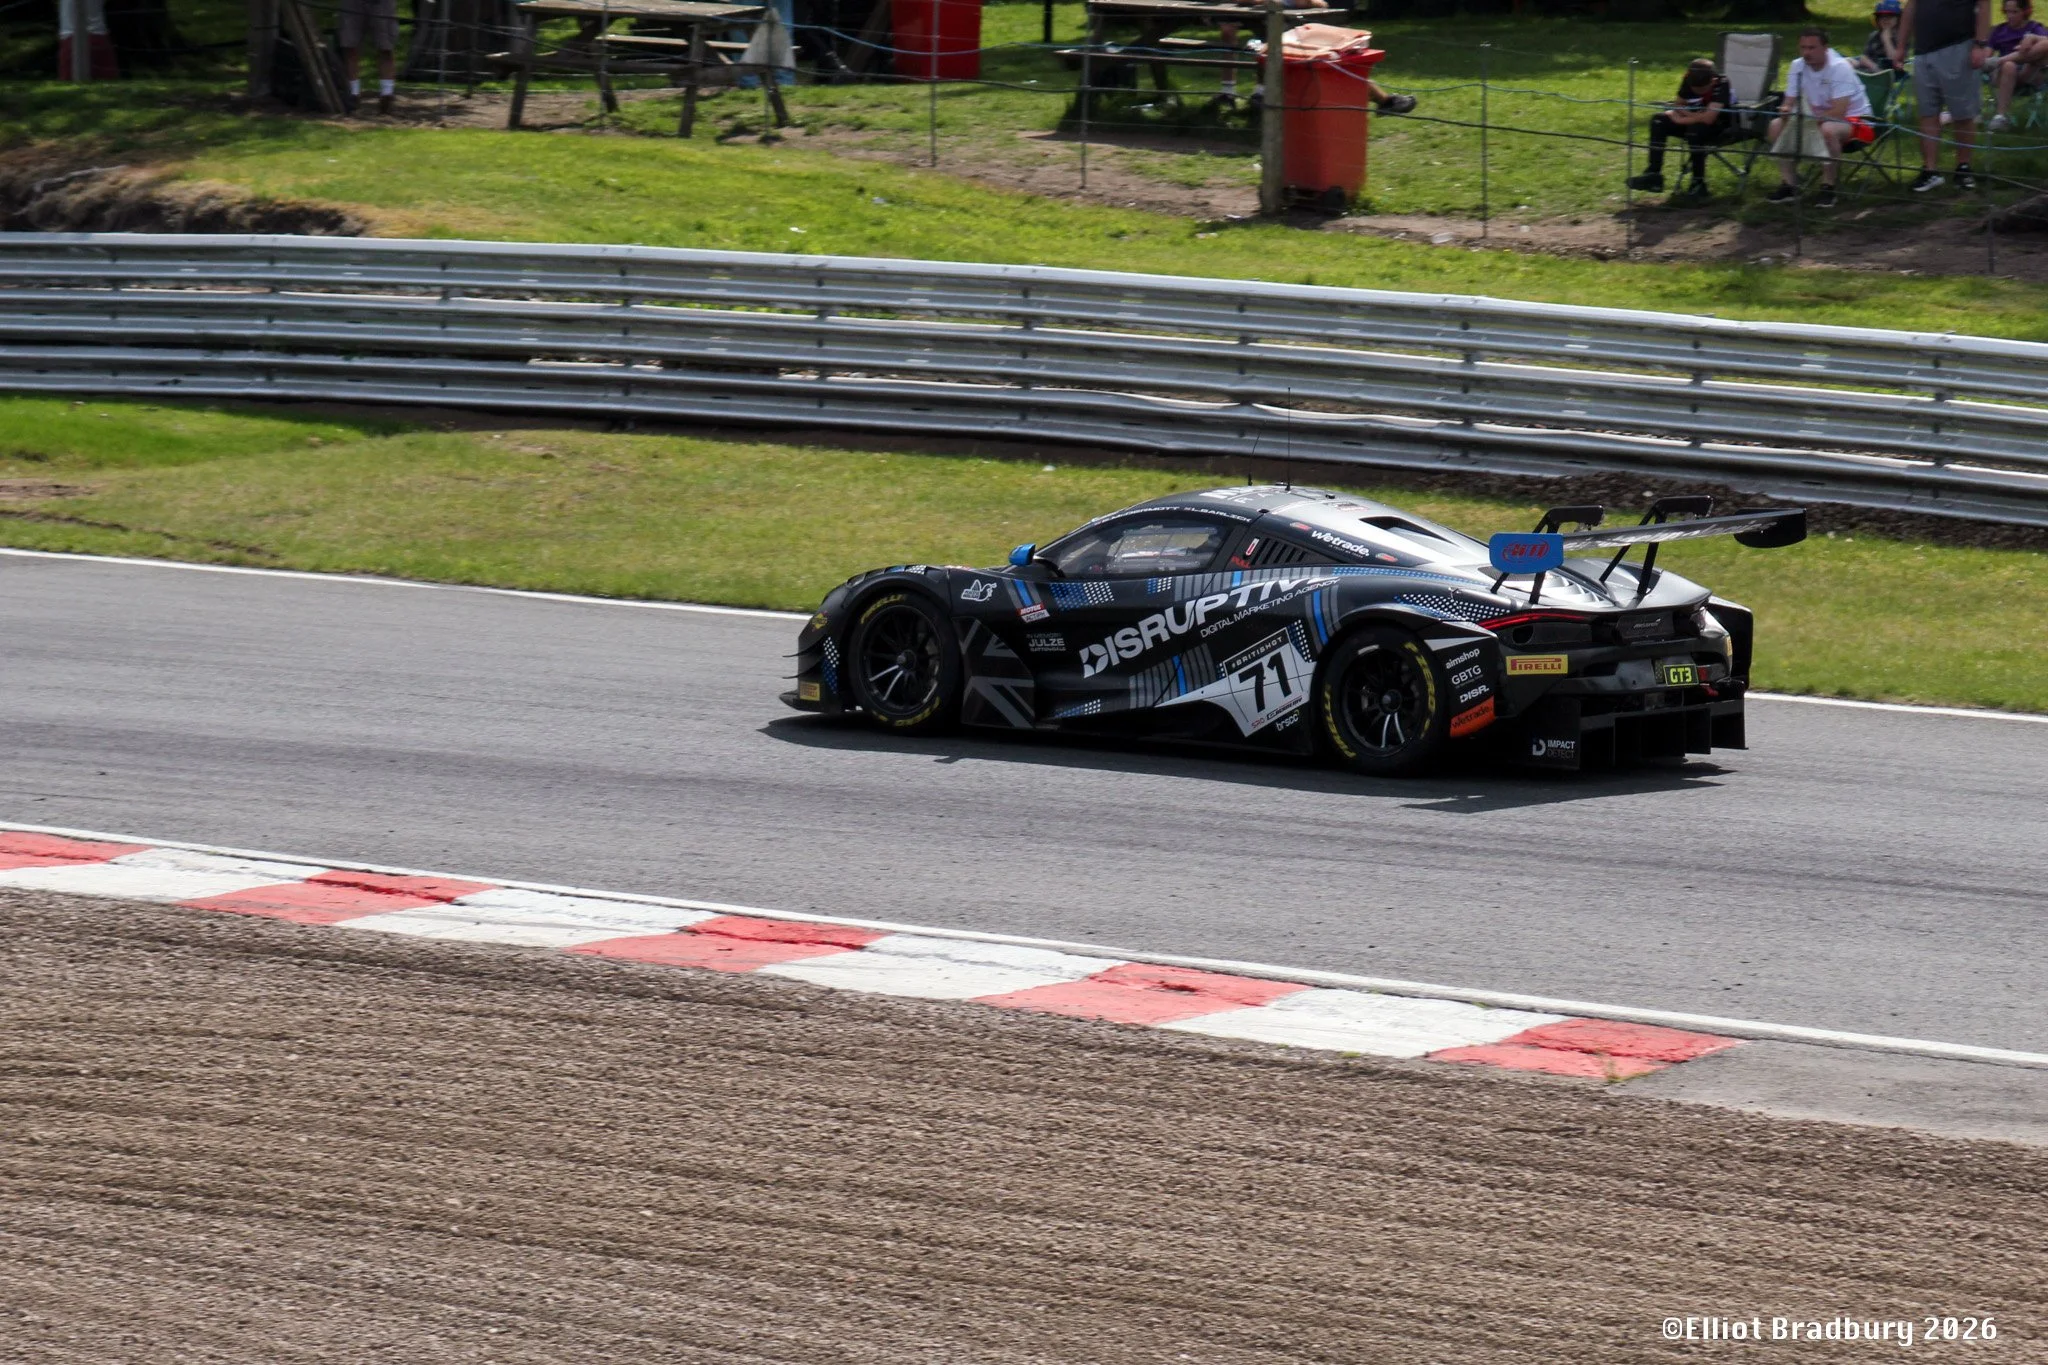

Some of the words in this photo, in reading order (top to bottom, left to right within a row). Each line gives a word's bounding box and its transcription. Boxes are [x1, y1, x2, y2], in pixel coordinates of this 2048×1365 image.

[1200, 619, 1235, 638] DIGITAL
[1234, 591, 1294, 622] MARKETING
[1294, 578, 1341, 597] AGENCY
[1029, 638, 1066, 647] JULZE
[1445, 648, 1480, 669] aimshop
[1510, 657, 1562, 671] PIRELLI
[1238, 652, 1292, 713] 71
[1451, 664, 1482, 686] GBTG
[1669, 667, 1692, 683] GT3
[1547, 739, 1576, 750] IMPACT
